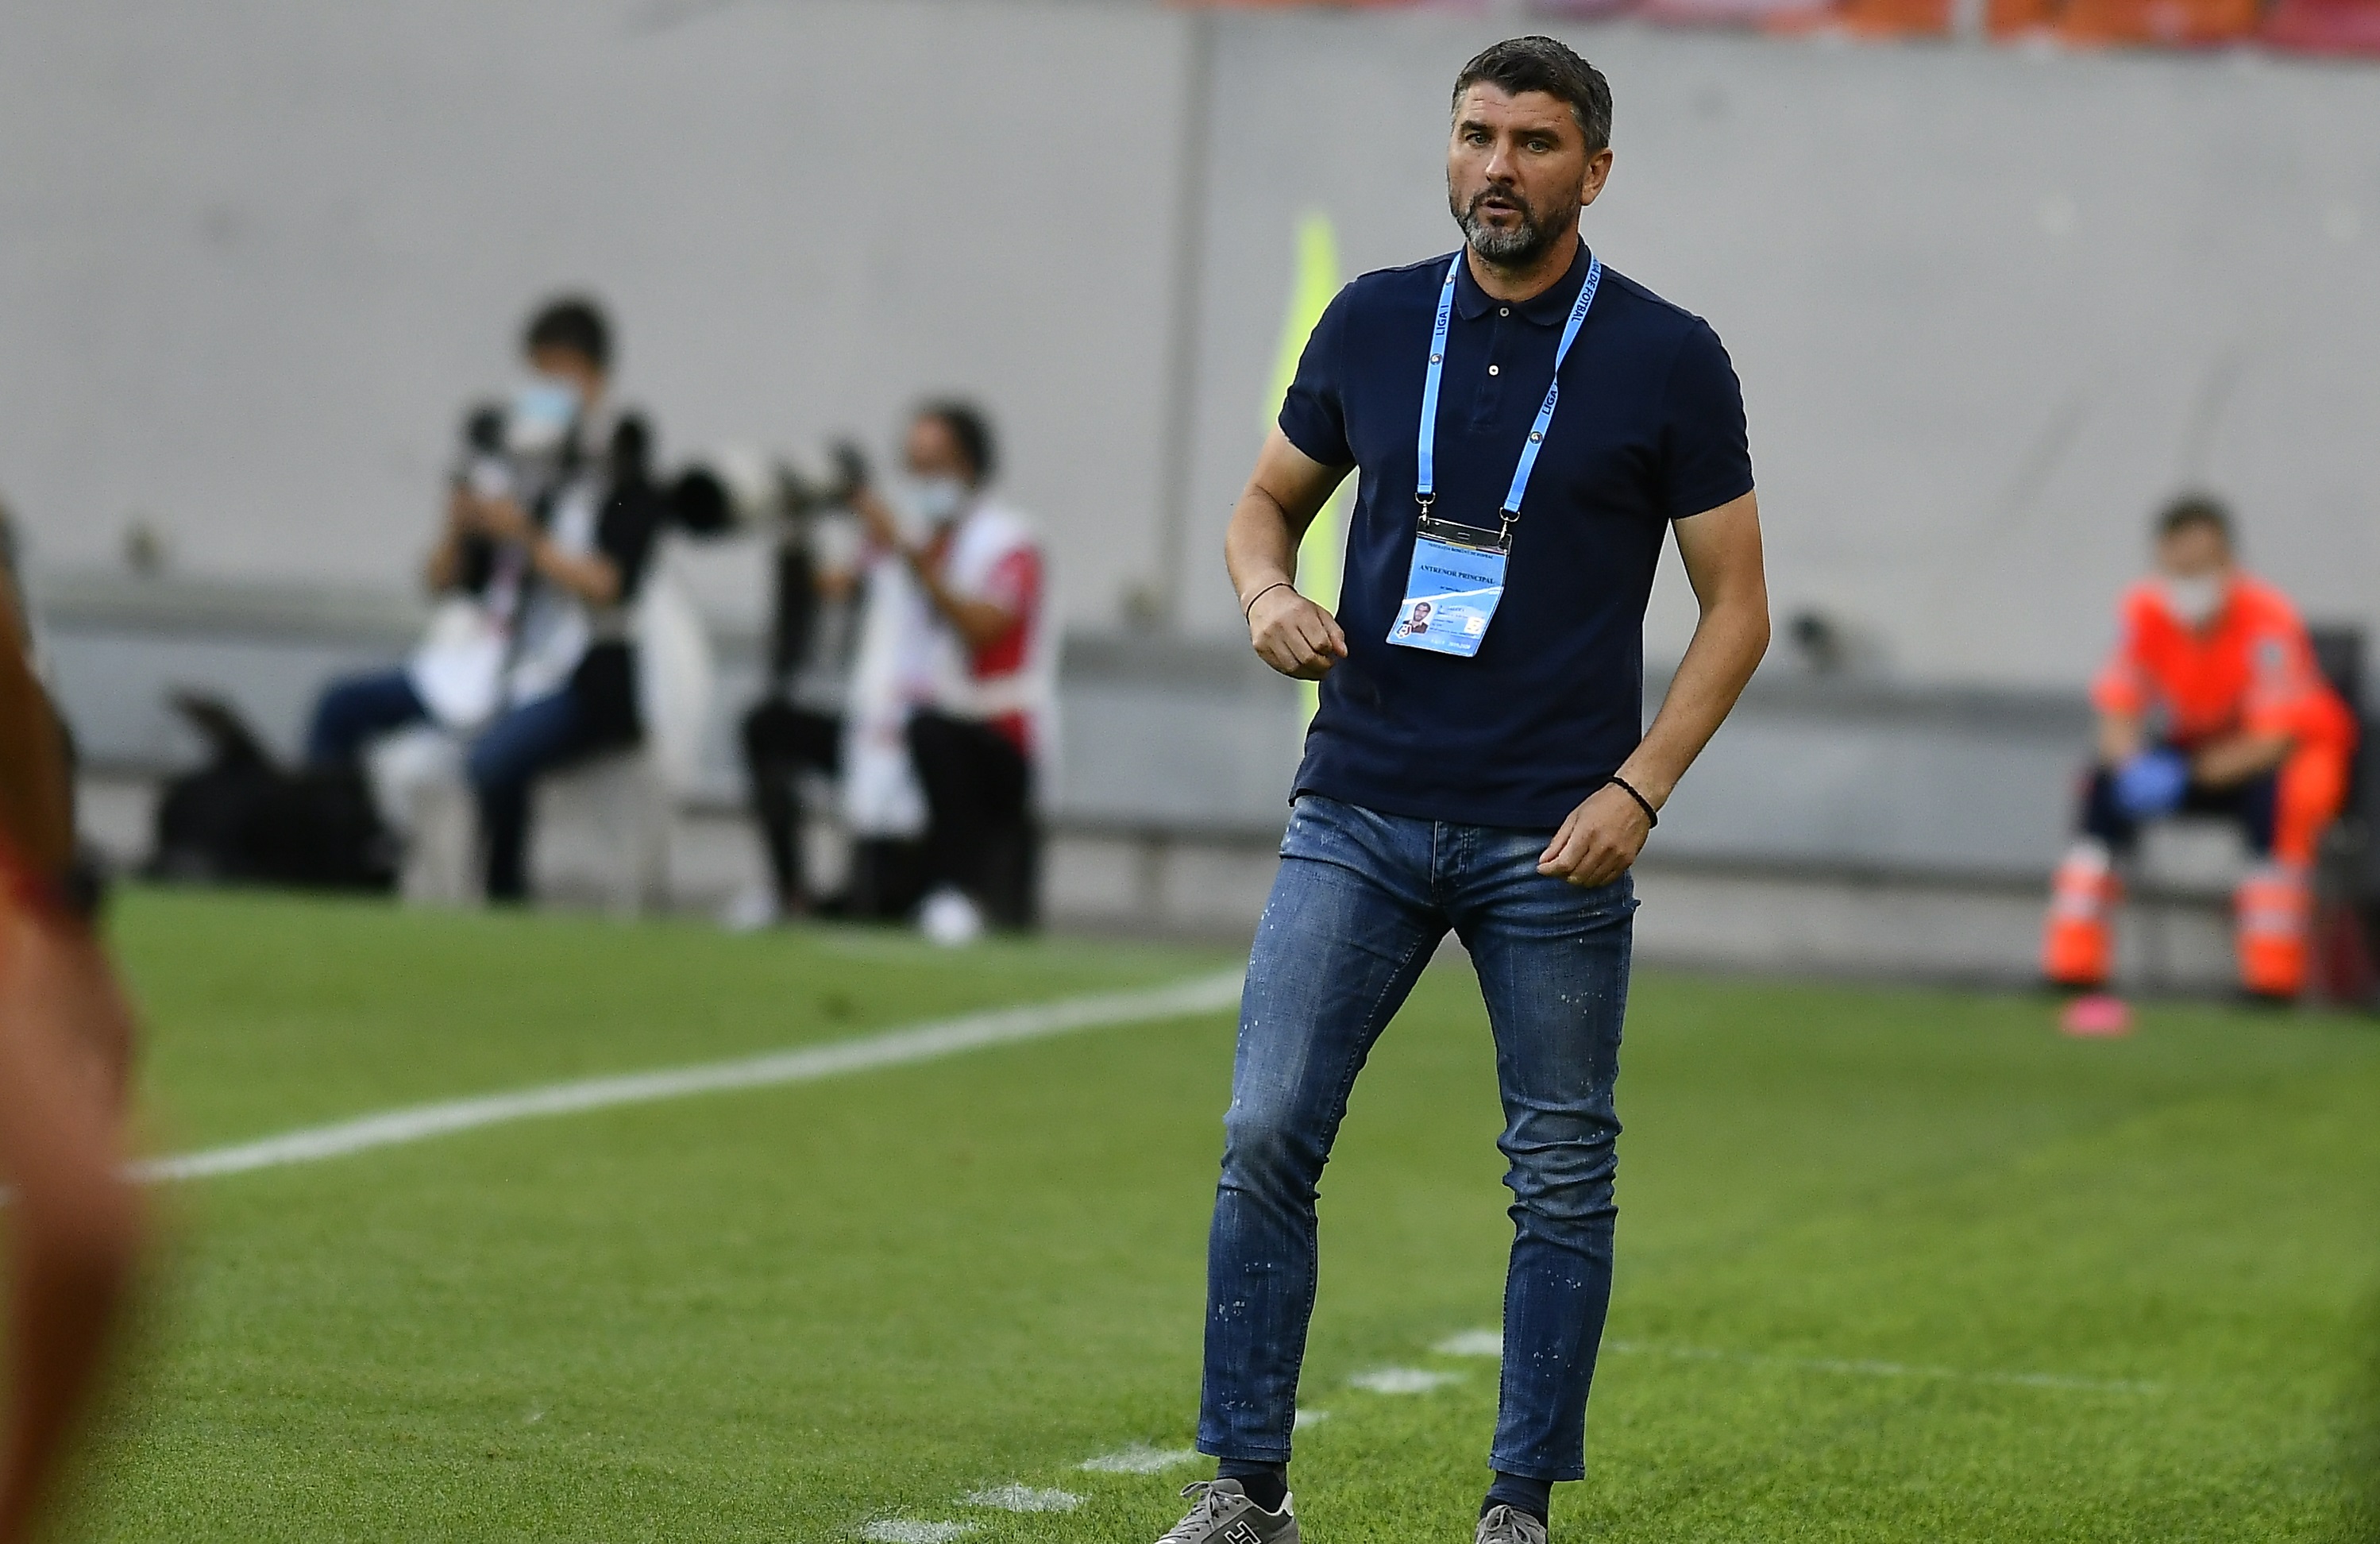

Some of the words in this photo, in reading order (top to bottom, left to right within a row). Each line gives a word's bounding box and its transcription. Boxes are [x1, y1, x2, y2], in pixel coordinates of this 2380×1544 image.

[1587, 272, 1598, 288] DE
[1571, 286, 1594, 322] FOTBAL
[1435, 311, 1448, 336] LIGA
[1541, 390, 1557, 415] LIGA
[1419, 564, 1457, 578] ANTRENOR
[1458, 571, 1495, 585] PRINCIPAL
